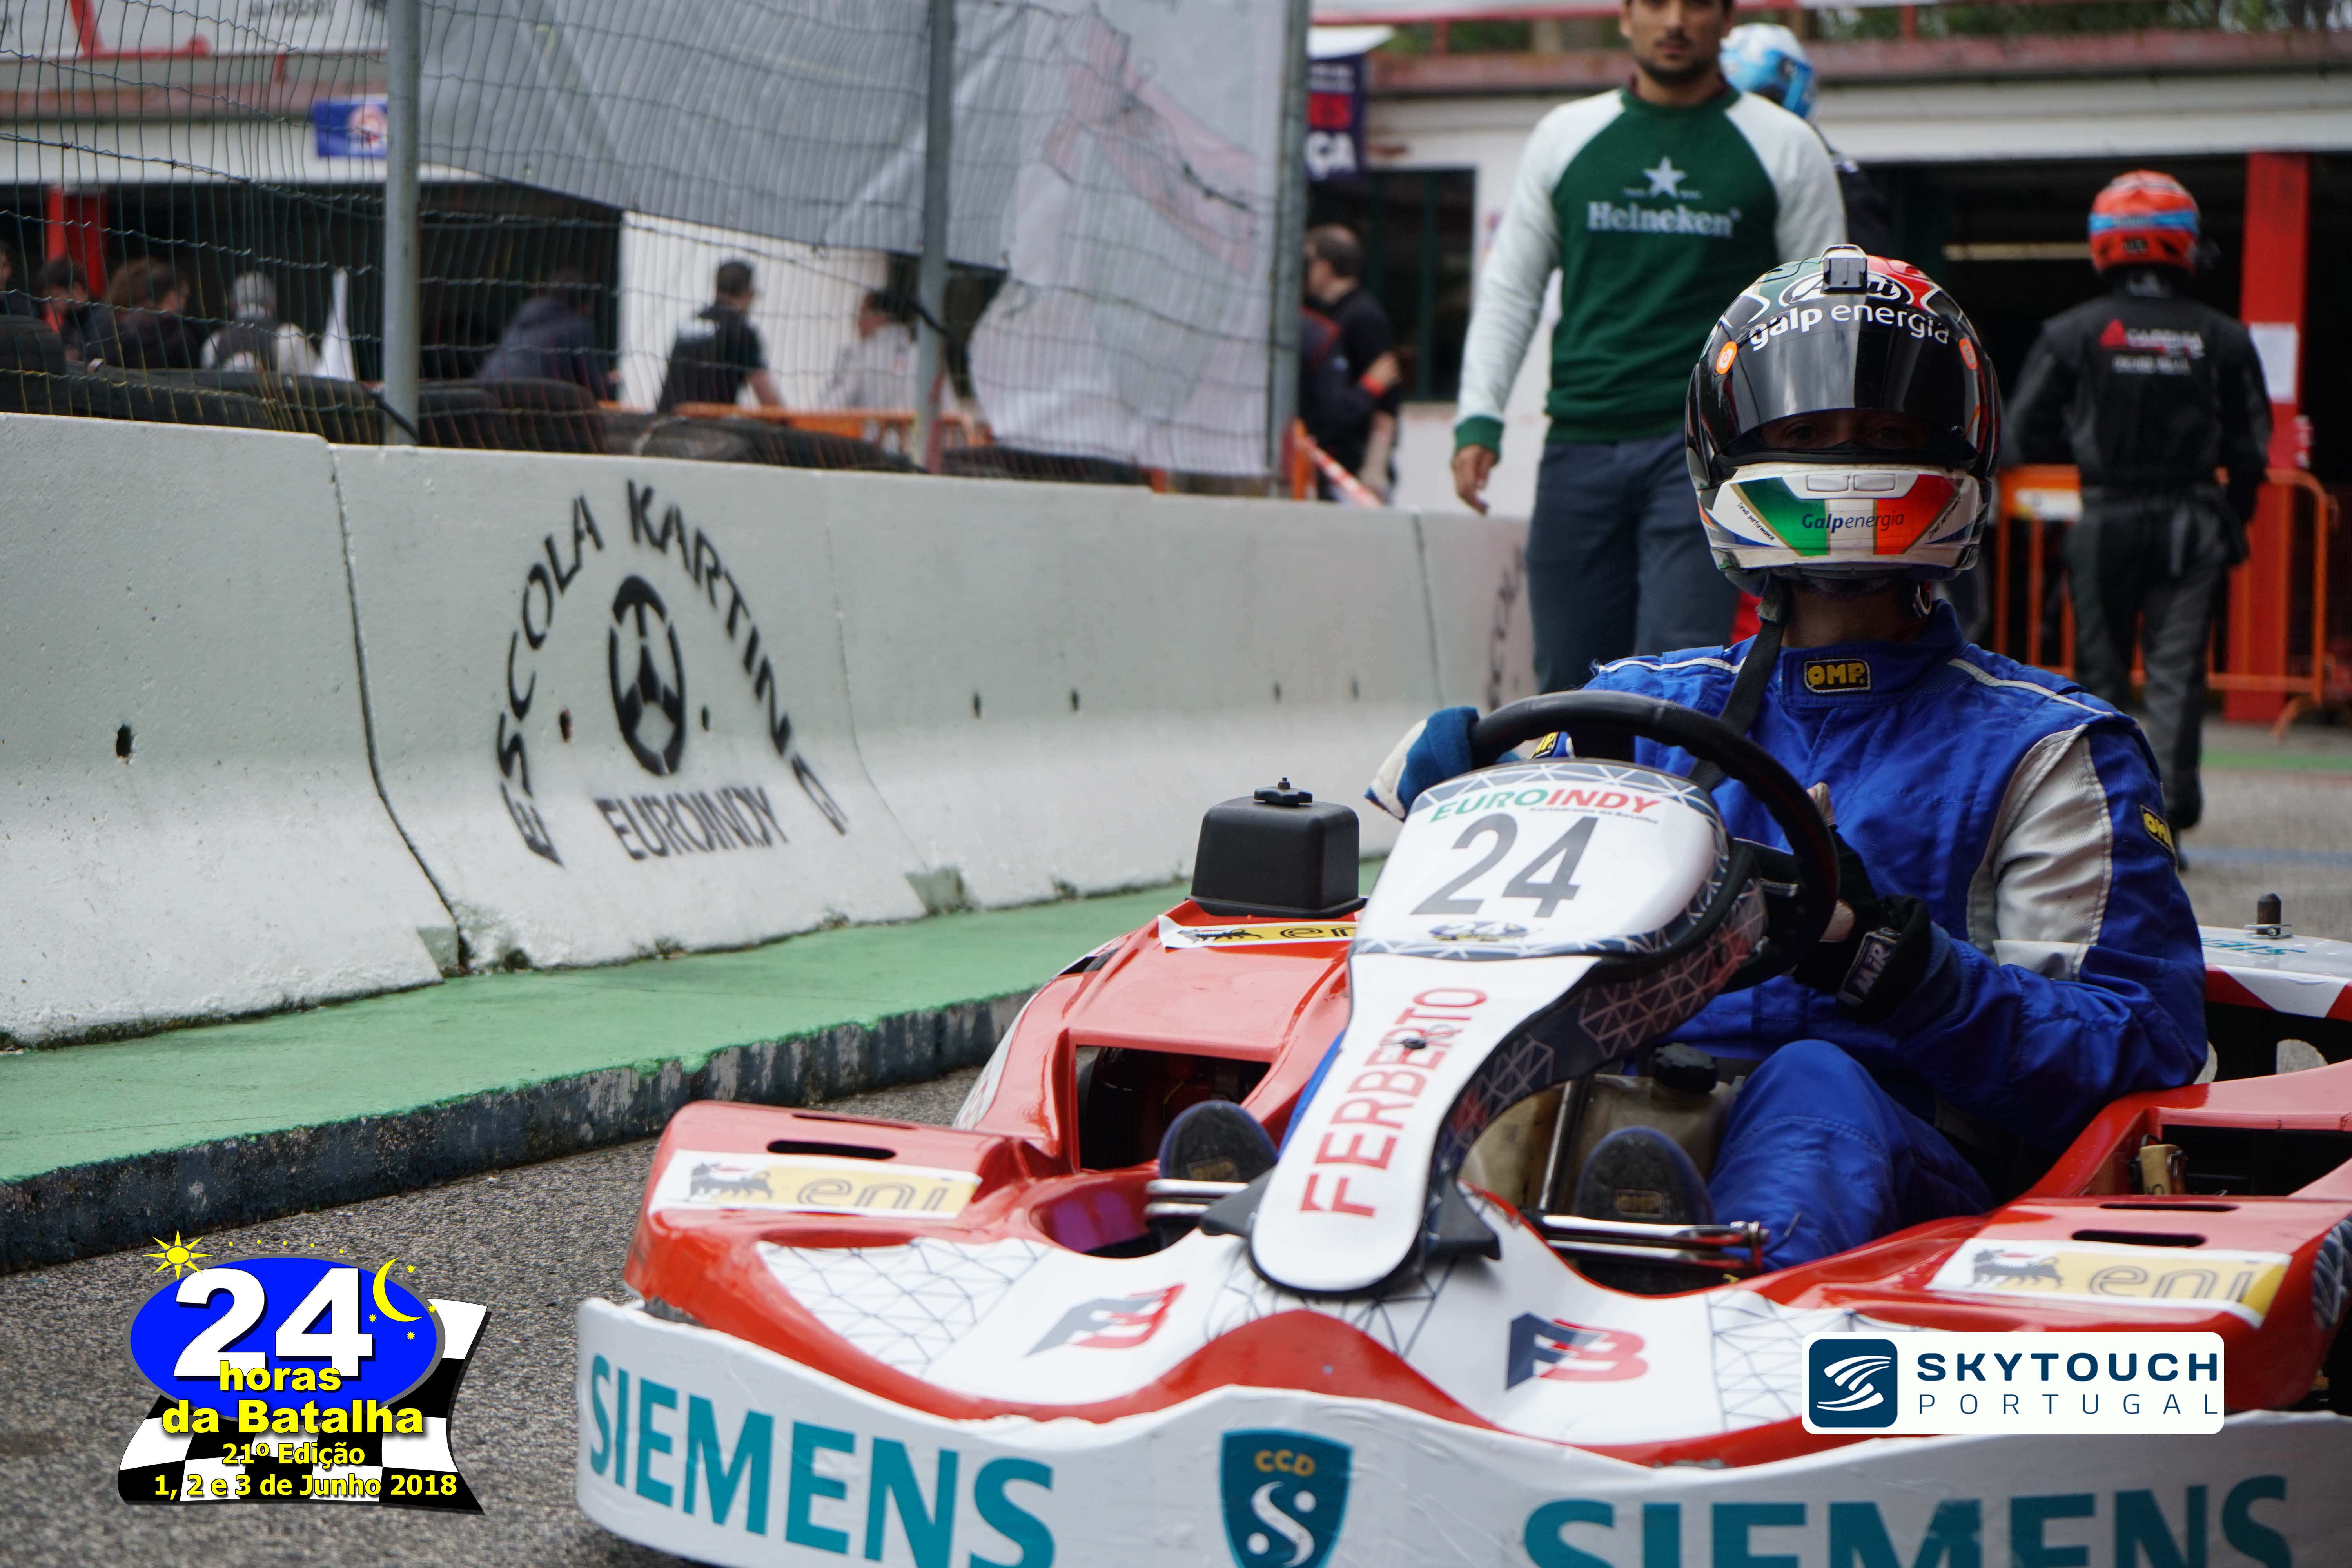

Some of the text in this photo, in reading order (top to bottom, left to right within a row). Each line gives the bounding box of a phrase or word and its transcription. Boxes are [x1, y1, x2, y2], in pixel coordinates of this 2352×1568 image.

[1587, 201, 1734, 238] Heineken
[1749, 304, 1950, 351] galp energia
[497, 479, 849, 867] ESCOLA KARTING
[593, 786, 790, 861] EUROINDY
[1429, 788, 1661, 822] EUROINDY
[1410, 813, 1599, 918] 24
[1300, 988, 1488, 1218] FERBERTO
[797, 1177, 957, 1211] eni
[2090, 1258, 2264, 1302] eni
[590, 1353, 1056, 1568] SIEMENS
[1254, 1449, 1316, 1477] CCD
[1524, 1474, 2292, 1568] SIEMENS
